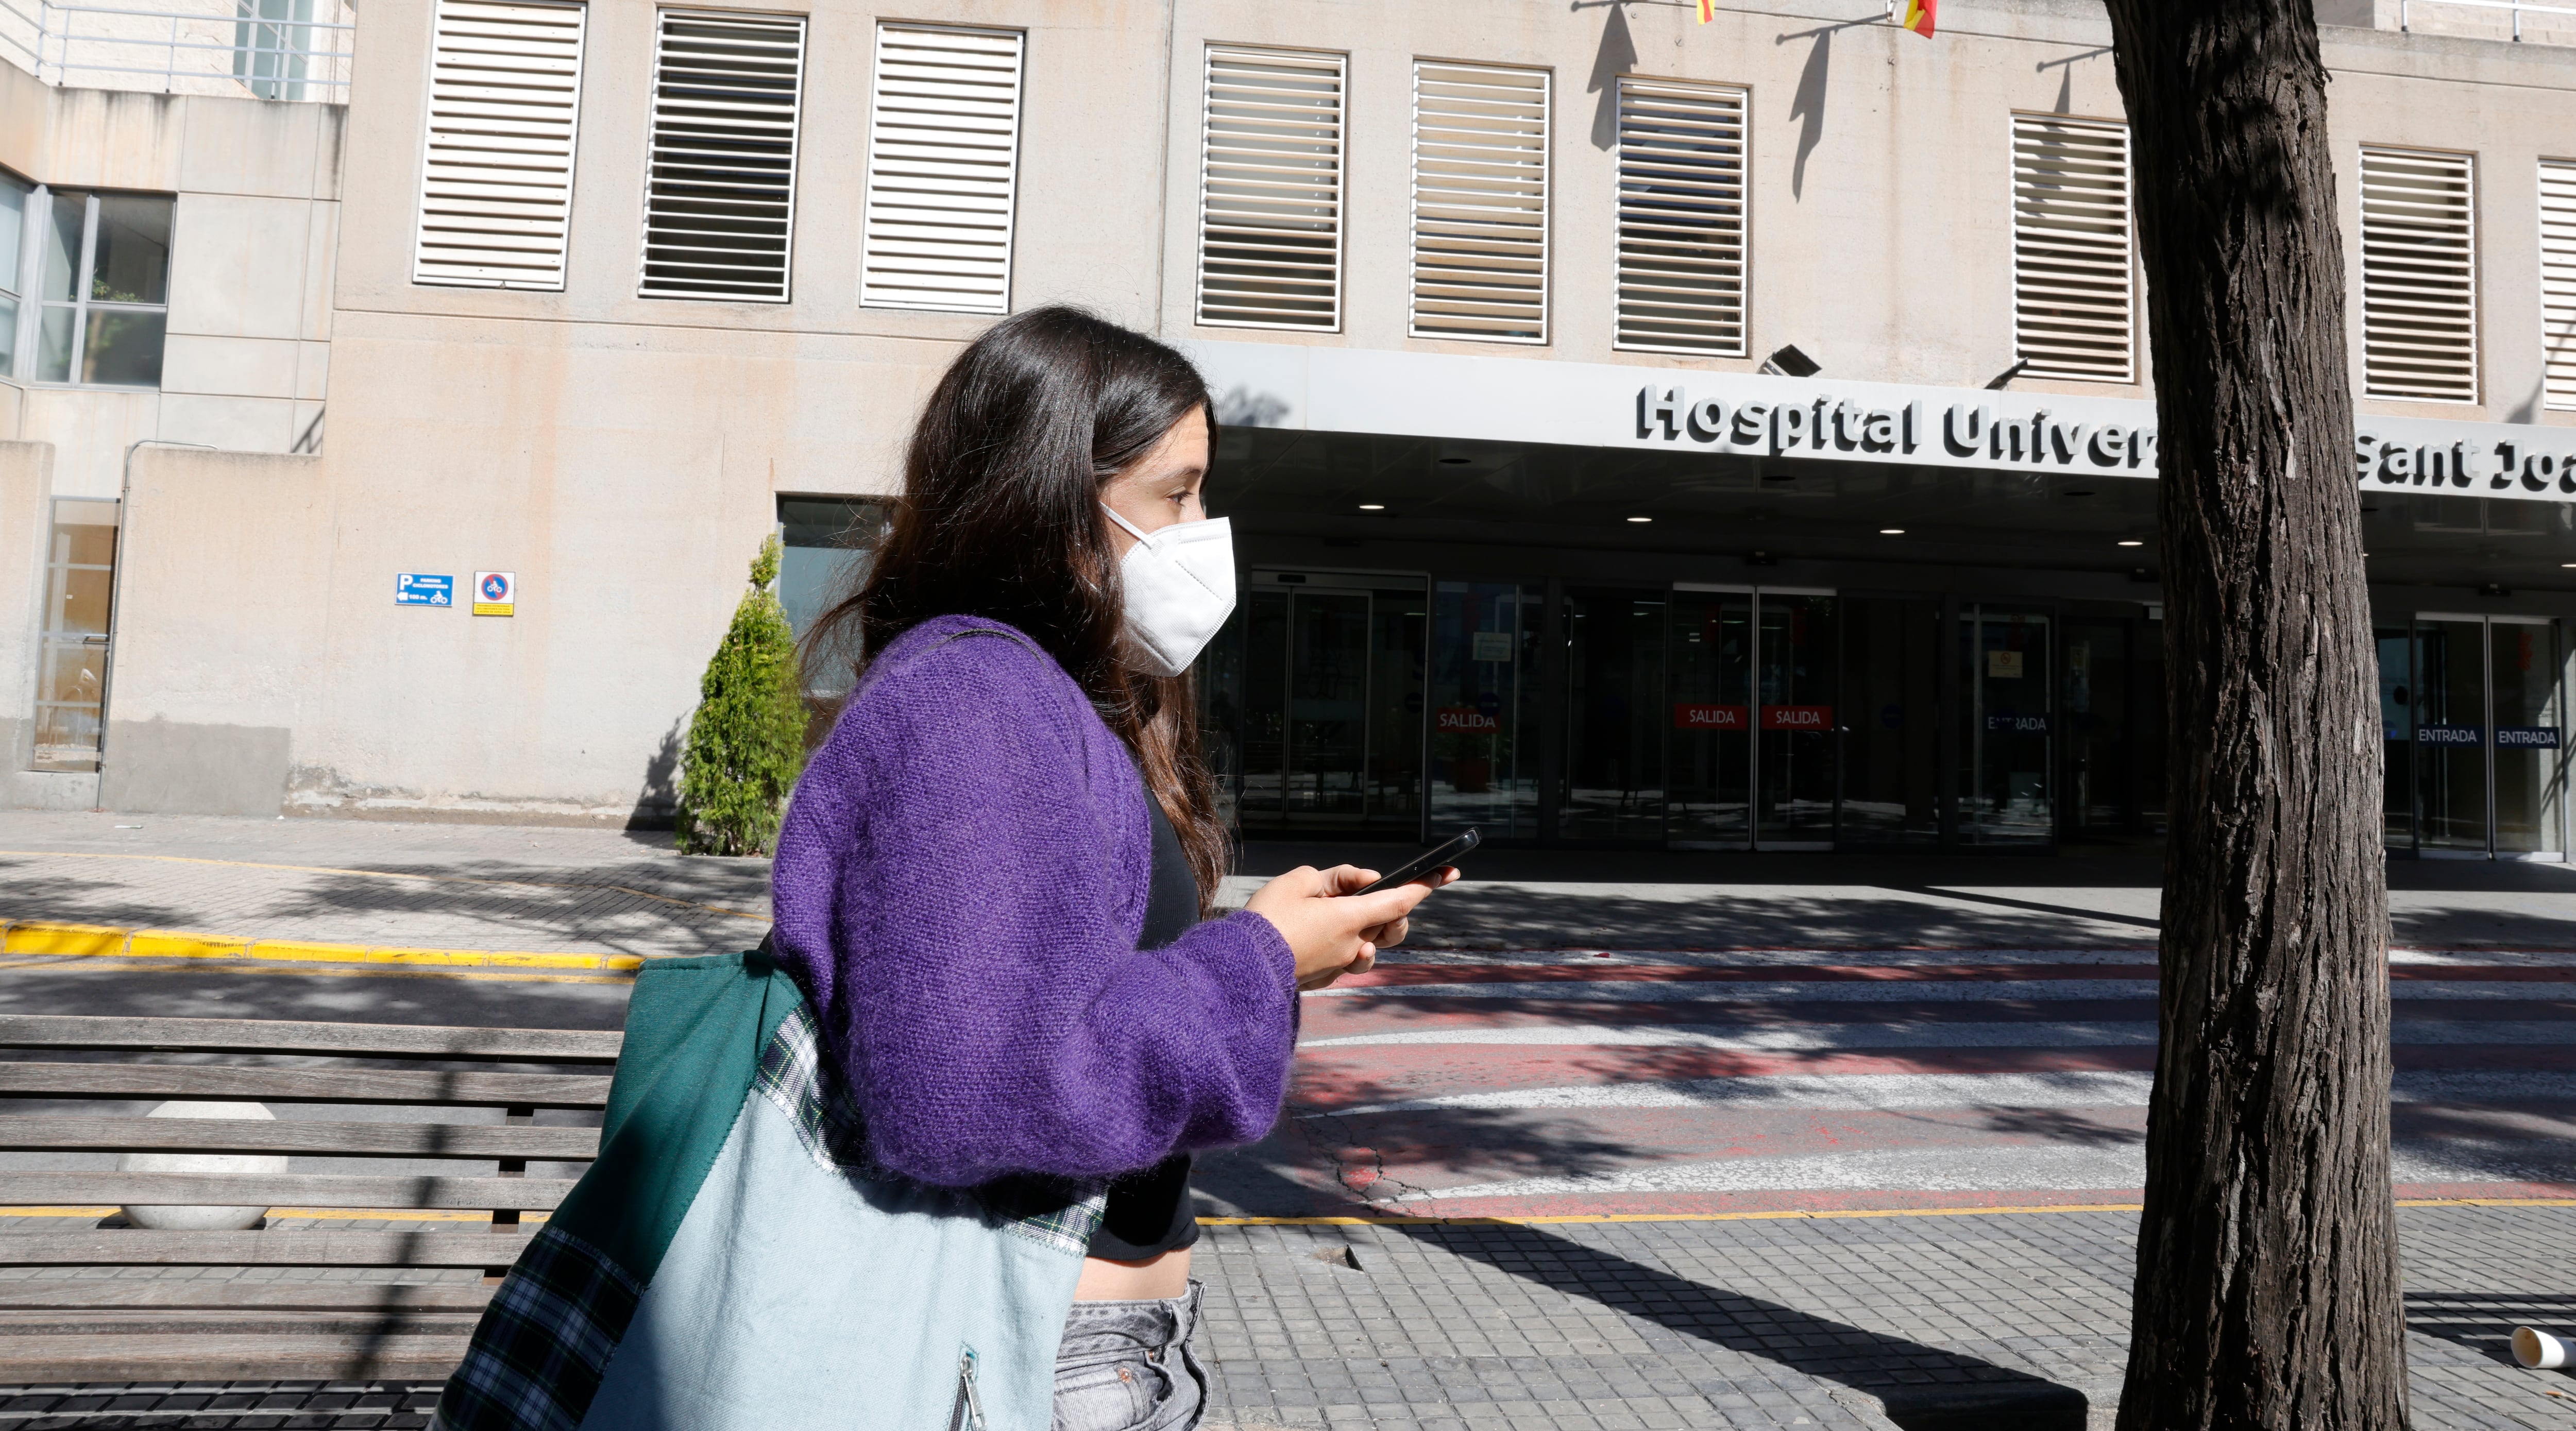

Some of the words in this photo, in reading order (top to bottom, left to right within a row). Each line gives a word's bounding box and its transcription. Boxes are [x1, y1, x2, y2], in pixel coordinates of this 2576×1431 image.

[1637, 384, 1922, 454] Hospital
[1945, 403, 2158, 467] Univer
[2353, 419, 2481, 488] Sant
[400, 575, 413, 590] P
[1439, 713, 1497, 728] SALIDA
[1689, 709, 1735, 724] SALIDA
[1776, 710, 1821, 724] SALIDA
[2418, 729, 2477, 743] ENTRADA
[2499, 730, 2557, 745] ENTRADA
